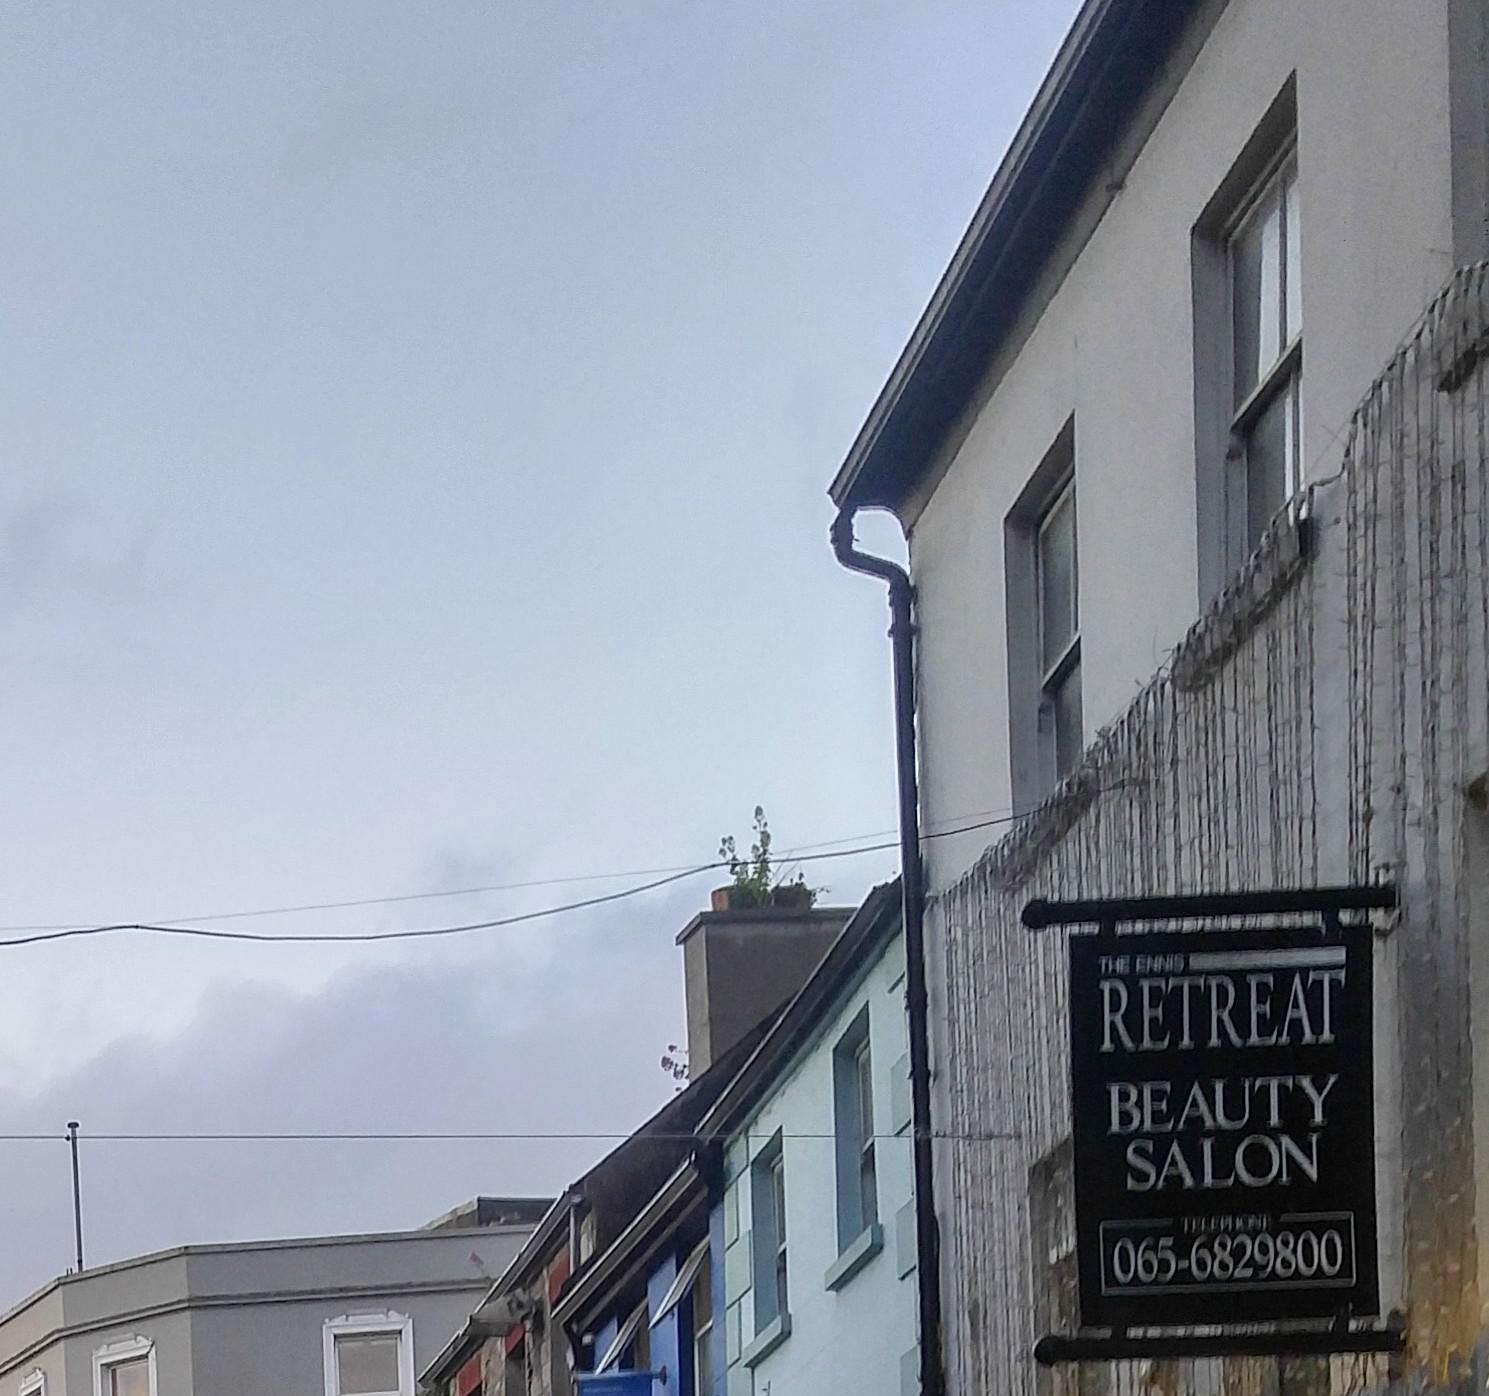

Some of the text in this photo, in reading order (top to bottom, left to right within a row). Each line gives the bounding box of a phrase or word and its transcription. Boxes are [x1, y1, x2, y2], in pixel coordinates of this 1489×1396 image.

[1097, 954, 1130, 976] THE
[1098, 968, 1347, 1053] RETREAT
[1105, 1073, 1341, 1137] BEAUTY
[1124, 1130, 1321, 1194] SALON
[1112, 1228, 1345, 1284] 065-6829800
